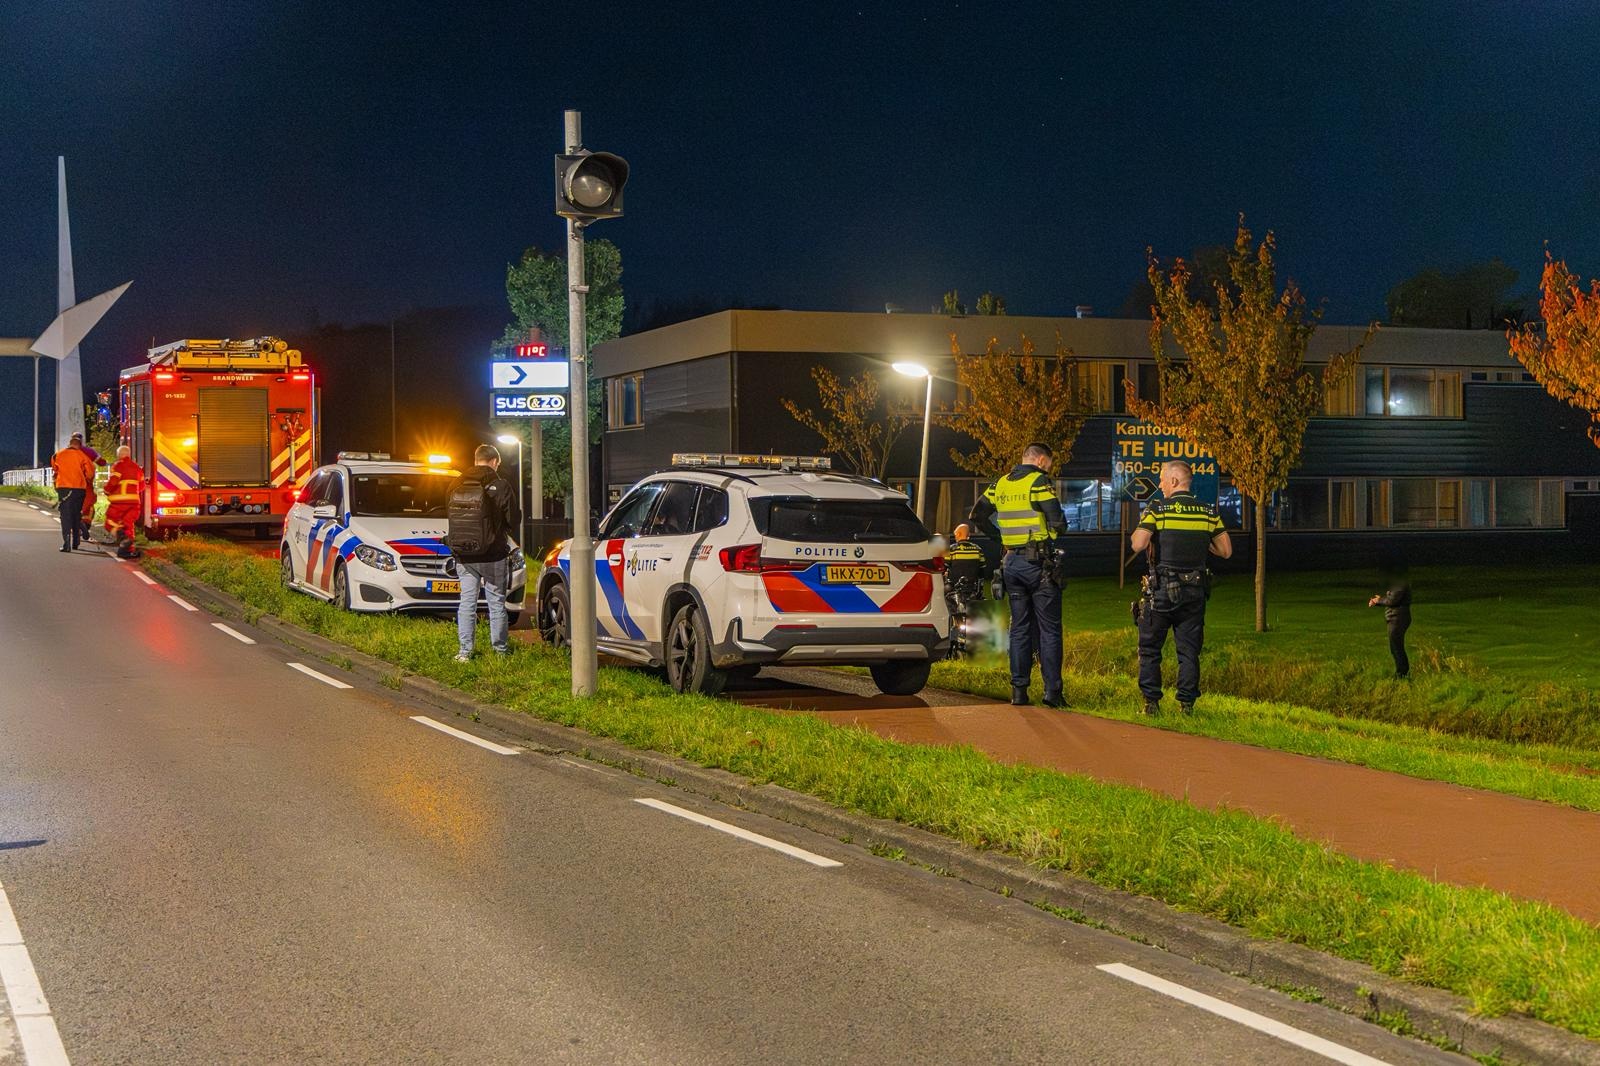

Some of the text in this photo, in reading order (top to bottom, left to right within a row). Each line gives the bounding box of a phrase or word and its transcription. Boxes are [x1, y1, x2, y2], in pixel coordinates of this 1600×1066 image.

[1118, 440, 1145, 457] TE
[795, 547, 847, 557] POLITIE
[626, 555, 658, 576] POLITIE
[830, 567, 886, 580] HKX-70-D
[437, 582, 459, 592] ZH-4
